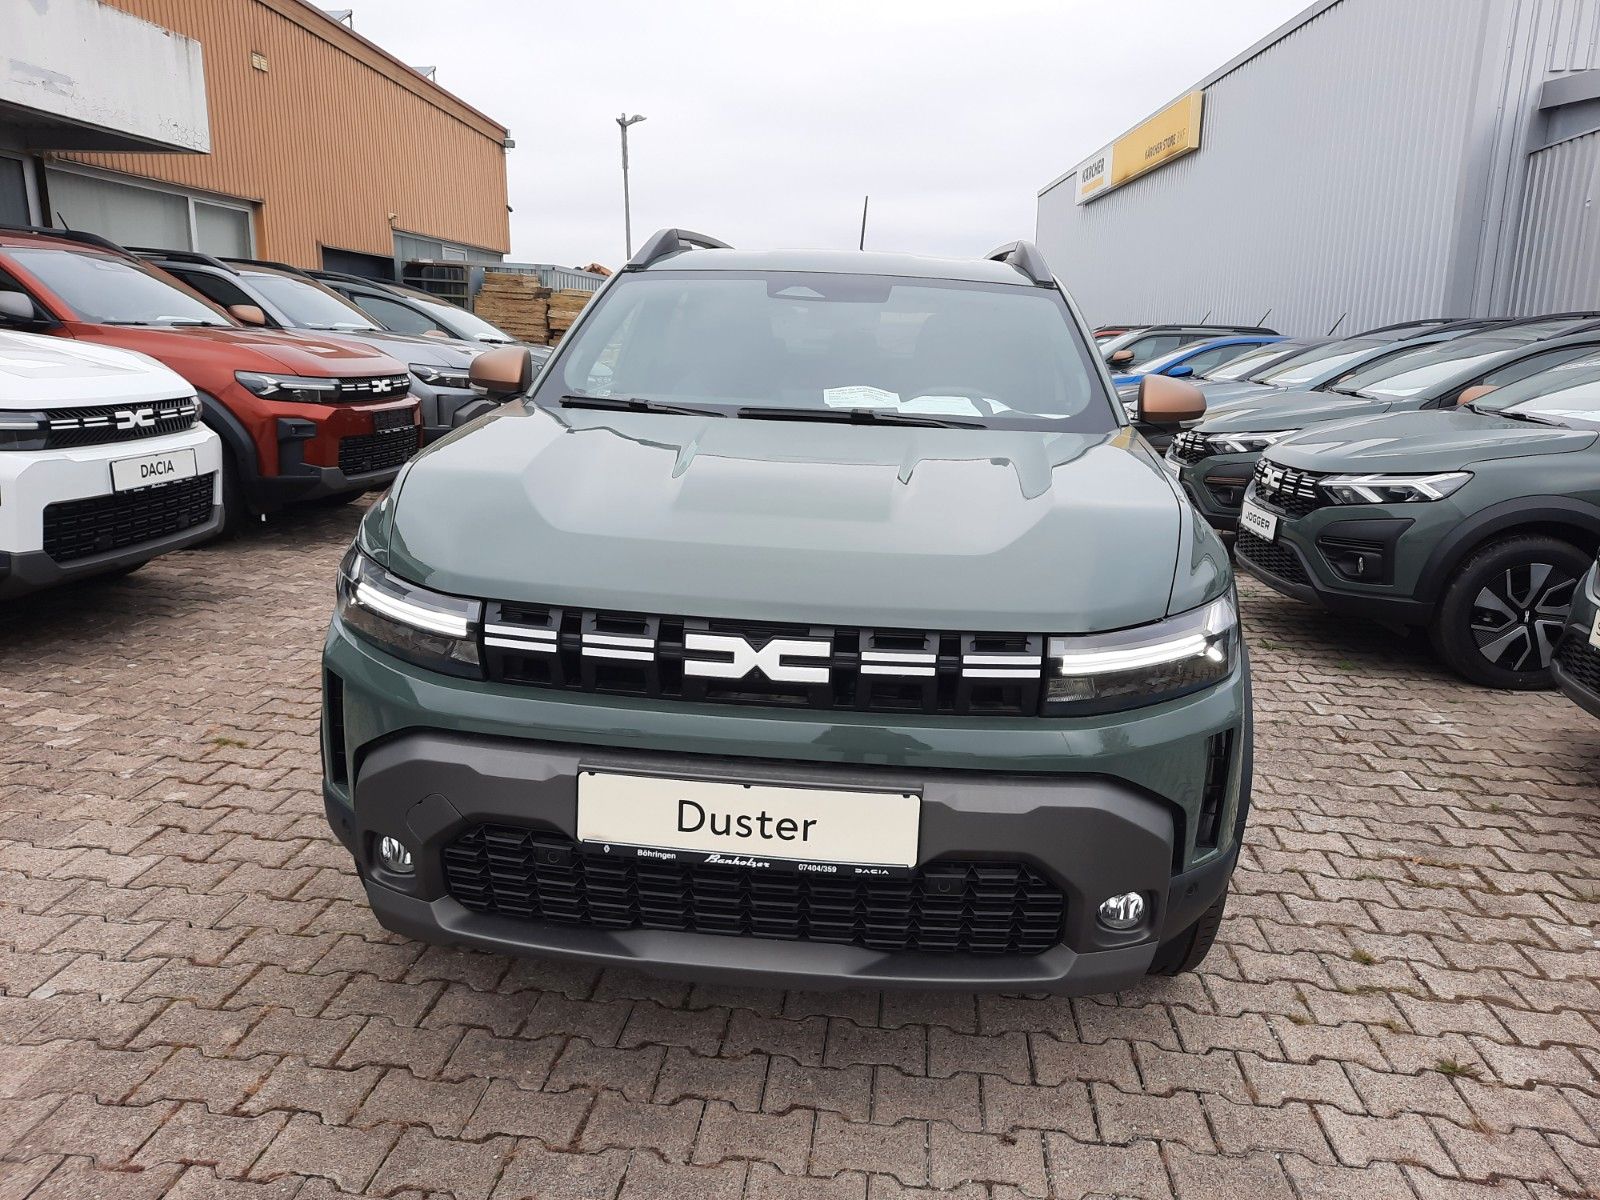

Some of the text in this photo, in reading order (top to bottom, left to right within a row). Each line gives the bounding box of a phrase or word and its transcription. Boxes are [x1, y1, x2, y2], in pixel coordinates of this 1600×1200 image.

[140, 460, 175, 478] DACIA
[1245, 511, 1271, 530] JOGGER
[677, 799, 818, 842] Duster
[636, 848, 890, 876] Böhringen Banholzer 07404/359 DACIA
